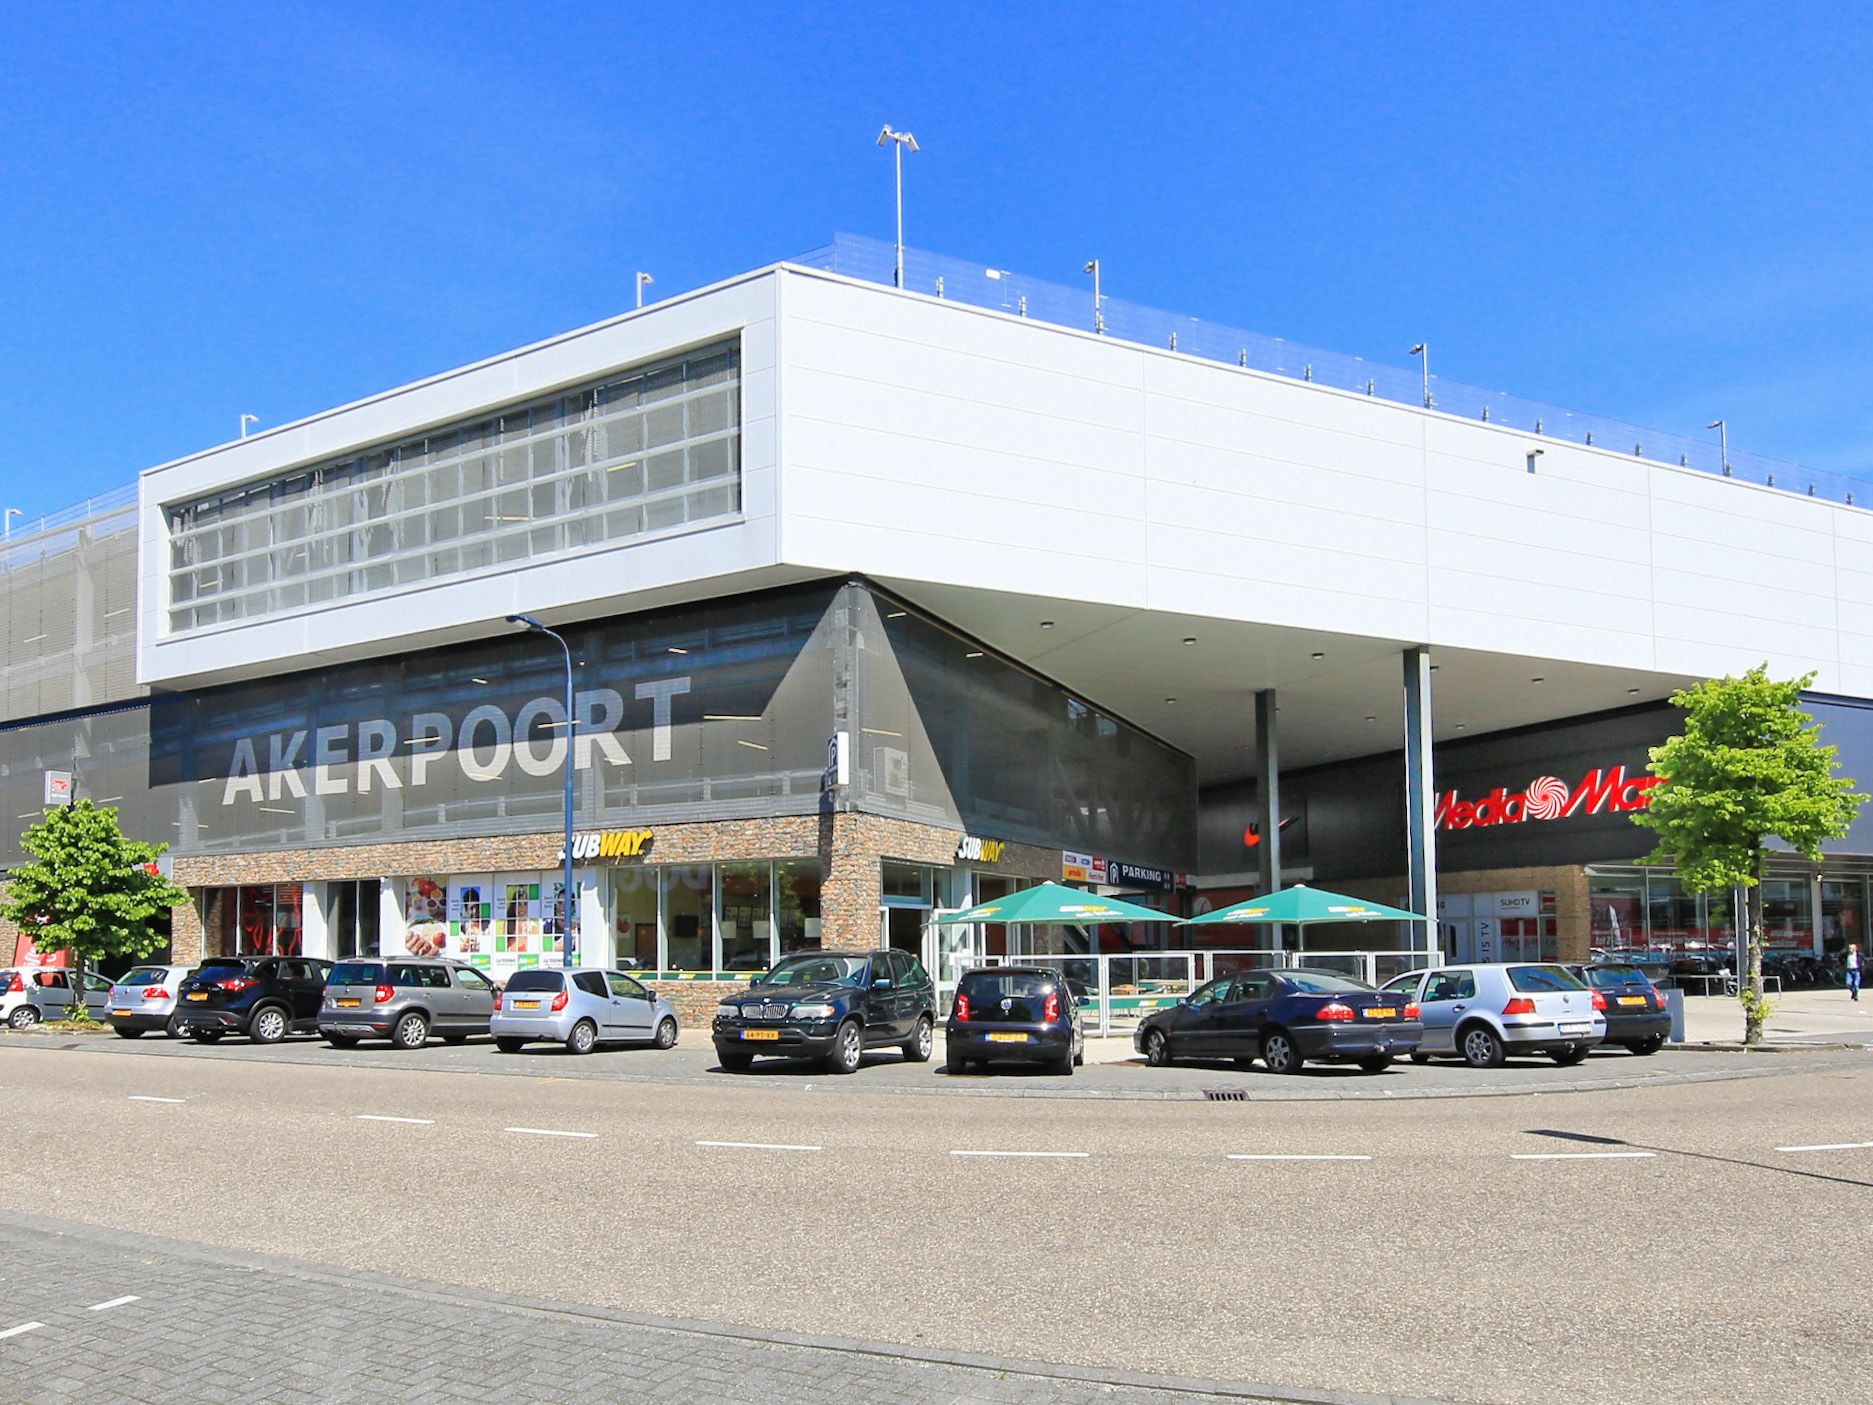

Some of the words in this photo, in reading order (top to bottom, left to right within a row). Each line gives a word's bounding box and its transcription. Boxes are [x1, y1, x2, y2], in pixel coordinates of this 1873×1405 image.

[222, 676, 691, 806] AKERPOORT
[958, 836, 1006, 862] SUBWAY
[1122, 864, 1162, 882] PARKING
